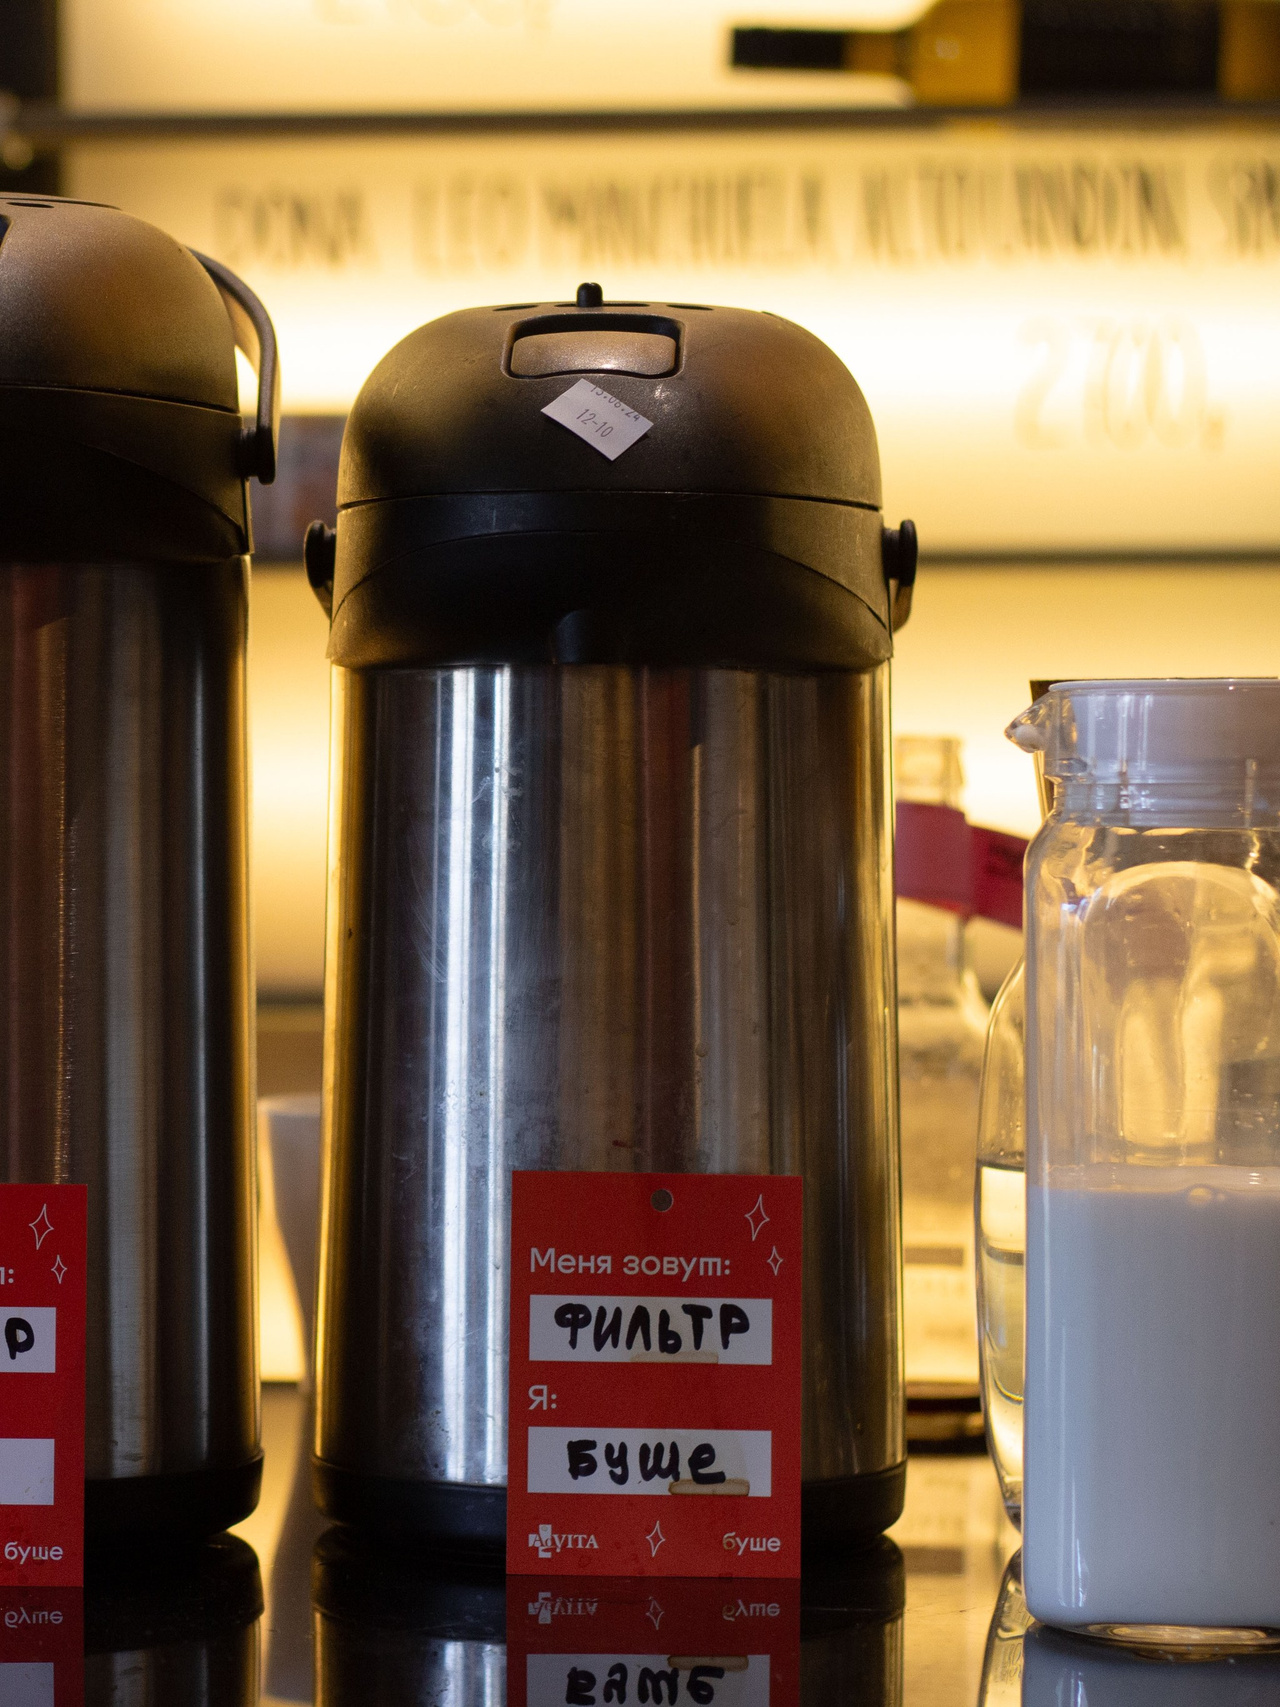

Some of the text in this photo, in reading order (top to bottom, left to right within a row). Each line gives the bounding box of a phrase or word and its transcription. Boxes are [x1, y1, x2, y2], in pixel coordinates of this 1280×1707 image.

[576, 408, 614, 438] 12-10
[531, 1248, 730, 1282] Меня зовут:
[554, 1303, 749, 1353] ФИЛЬТР
[529, 1385, 556, 1410] Я:
[4, 1542, 63, 1565] буше
[723, 1532, 781, 1555] буше
